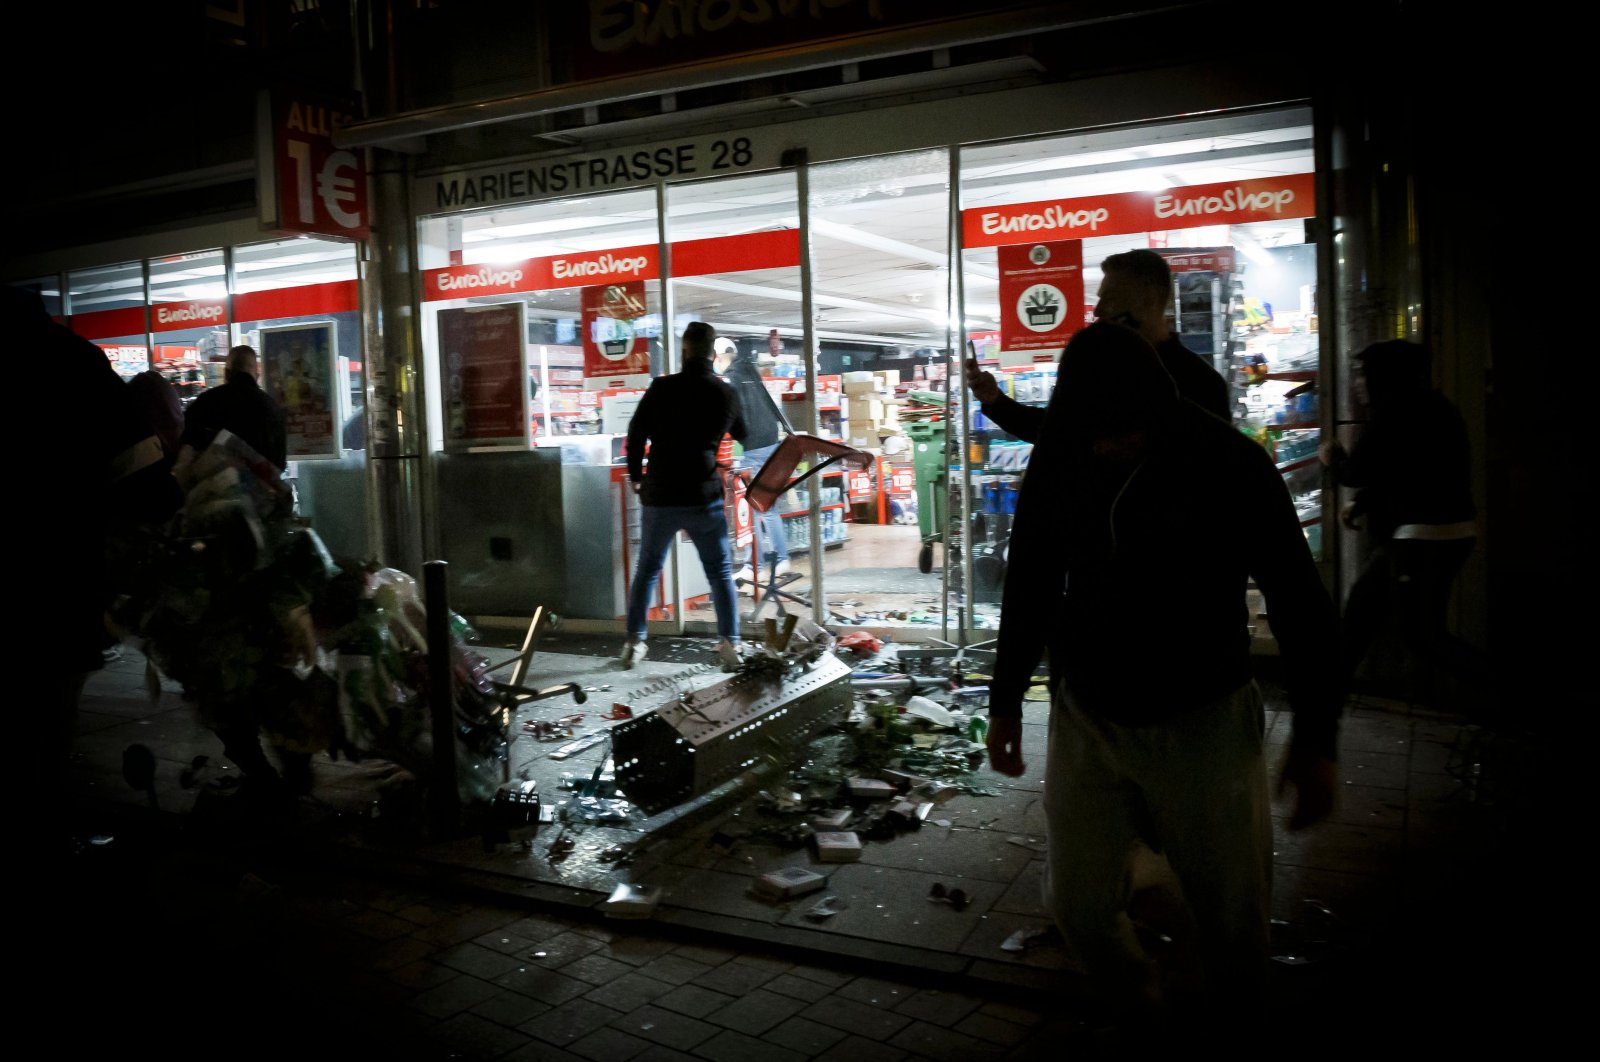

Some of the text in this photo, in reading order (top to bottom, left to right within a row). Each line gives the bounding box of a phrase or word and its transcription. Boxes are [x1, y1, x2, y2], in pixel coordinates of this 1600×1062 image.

[435, 137, 753, 207] MARIENSTRASSE 28
[1153, 185, 1295, 220] EuroShop
[981, 204, 1109, 235] EuroShop
[437, 267, 523, 291] EuroShop
[552, 253, 648, 279] EuroShop
[157, 304, 223, 324] EuroShop
